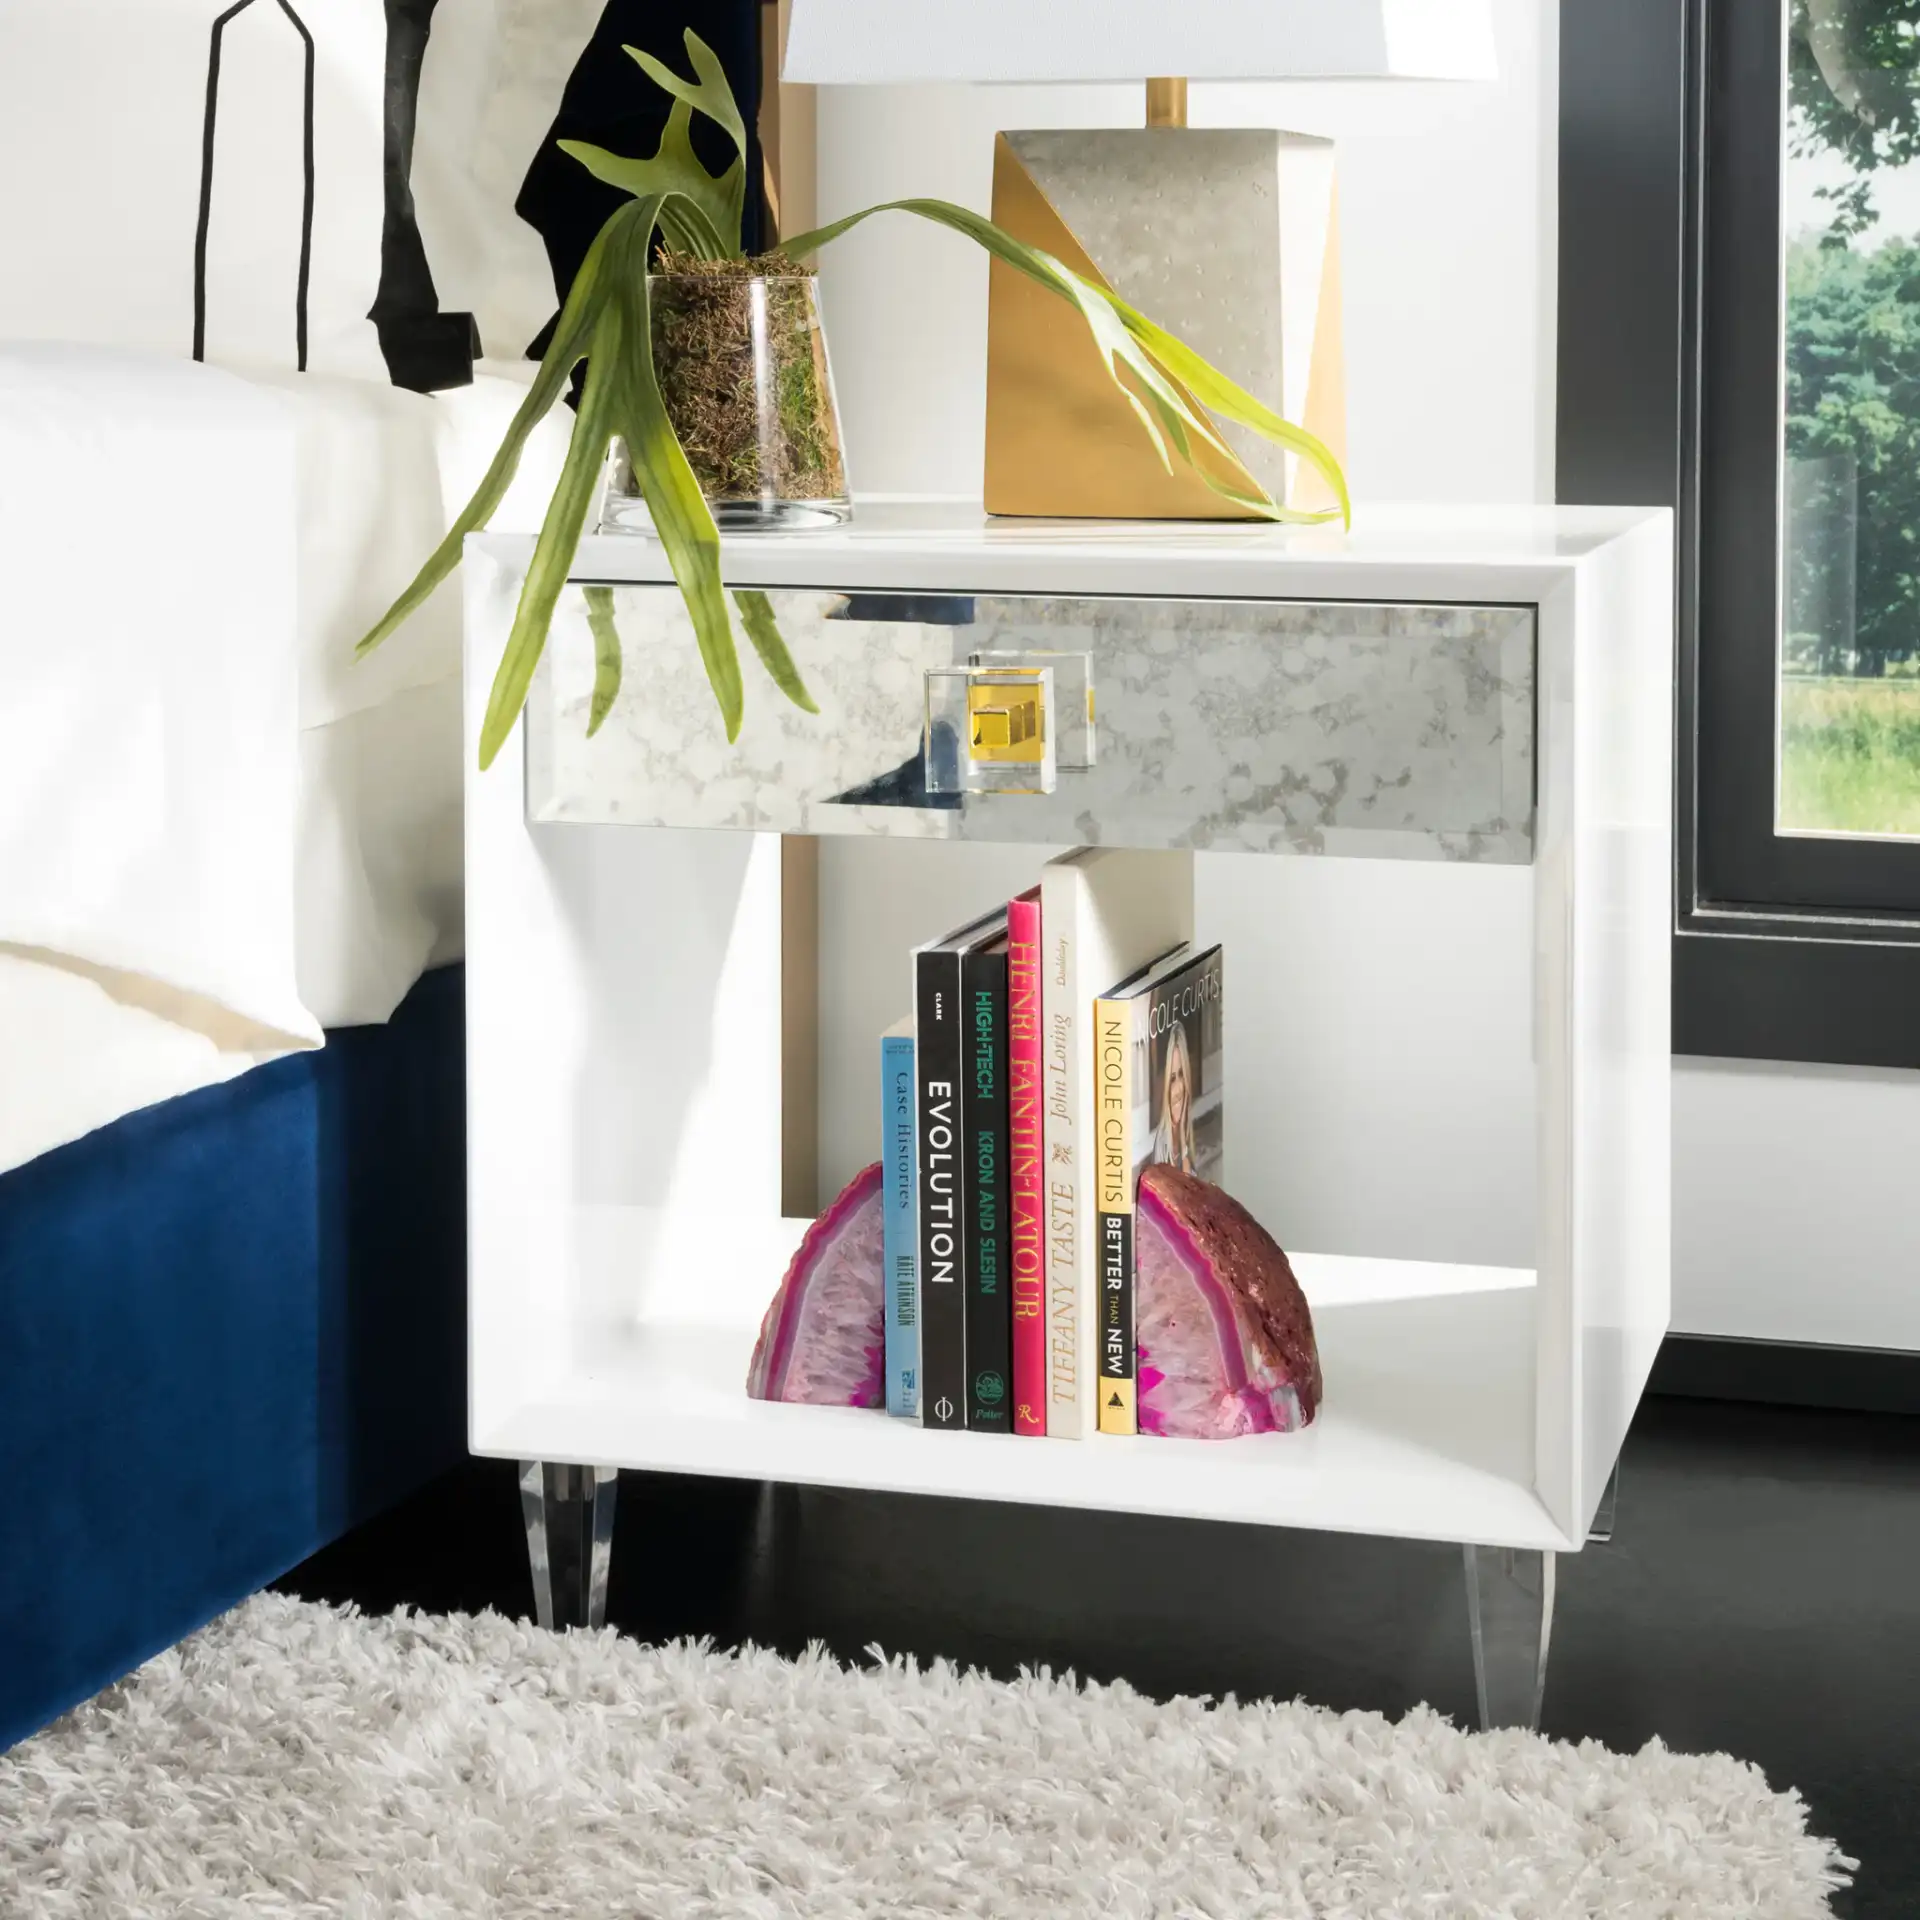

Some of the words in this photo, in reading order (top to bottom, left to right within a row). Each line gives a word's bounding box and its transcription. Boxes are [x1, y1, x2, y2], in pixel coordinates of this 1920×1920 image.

[934, 992, 943, 1021] CLARK
[1011, 942, 1036, 1041] HENRI
[1181, 968, 1220, 1017] CURTIS
[1049, 1013, 1071, 1075] Loring
[1104, 1021, 1122, 1110] NICOLE
[895, 1072, 908, 1115] Case
[1049, 1080, 1072, 1126] John
[896, 1123, 911, 1209] Histories
[928, 1081, 954, 1283] EVOLUTION
[978, 1131, 995, 1184] KRON
[1105, 1121, 1123, 1203] CURTIS
[979, 1191, 995, 1232] AND
[1051, 1182, 1074, 1273] TASTE
[896, 1255, 914, 1277] KATE
[980, 1238, 996, 1294] SLESIN
[1106, 1217, 1122, 1290] BETTER
[896, 1280, 916, 1327] ATKINSON
[1109, 1292, 1119, 1325] THAN
[1052, 1275, 1076, 1403] TIFFANY
[1107, 1328, 1123, 1375] NEW
[975, 1408, 1004, 1420] Potter
